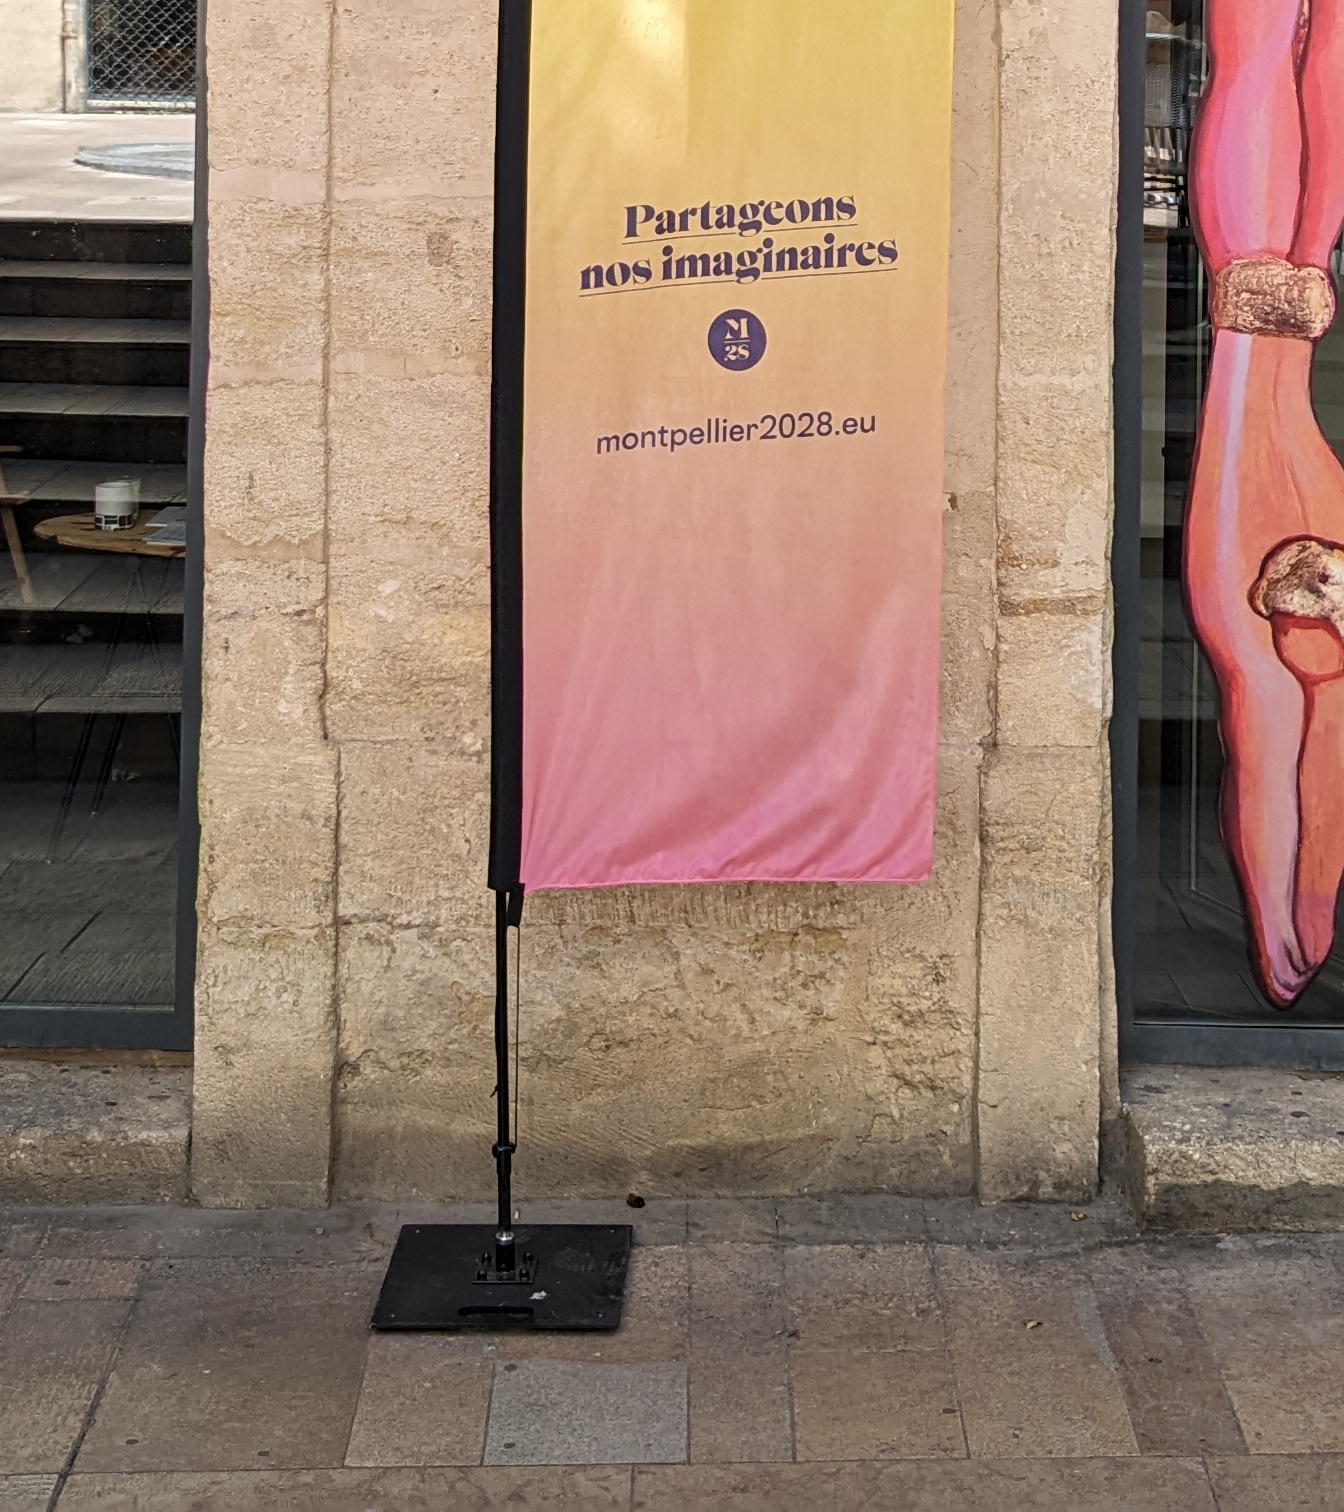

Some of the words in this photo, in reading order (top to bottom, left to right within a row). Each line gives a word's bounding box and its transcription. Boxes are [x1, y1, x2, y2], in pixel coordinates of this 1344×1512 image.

[623, 194, 857, 238] Partageons
[579, 258, 653, 291] nos
[660, 232, 899, 285] imaginaires
[725, 317, 749, 340] M
[724, 344, 750, 361] 28
[596, 410, 877, 454] montpellier2028.eu
